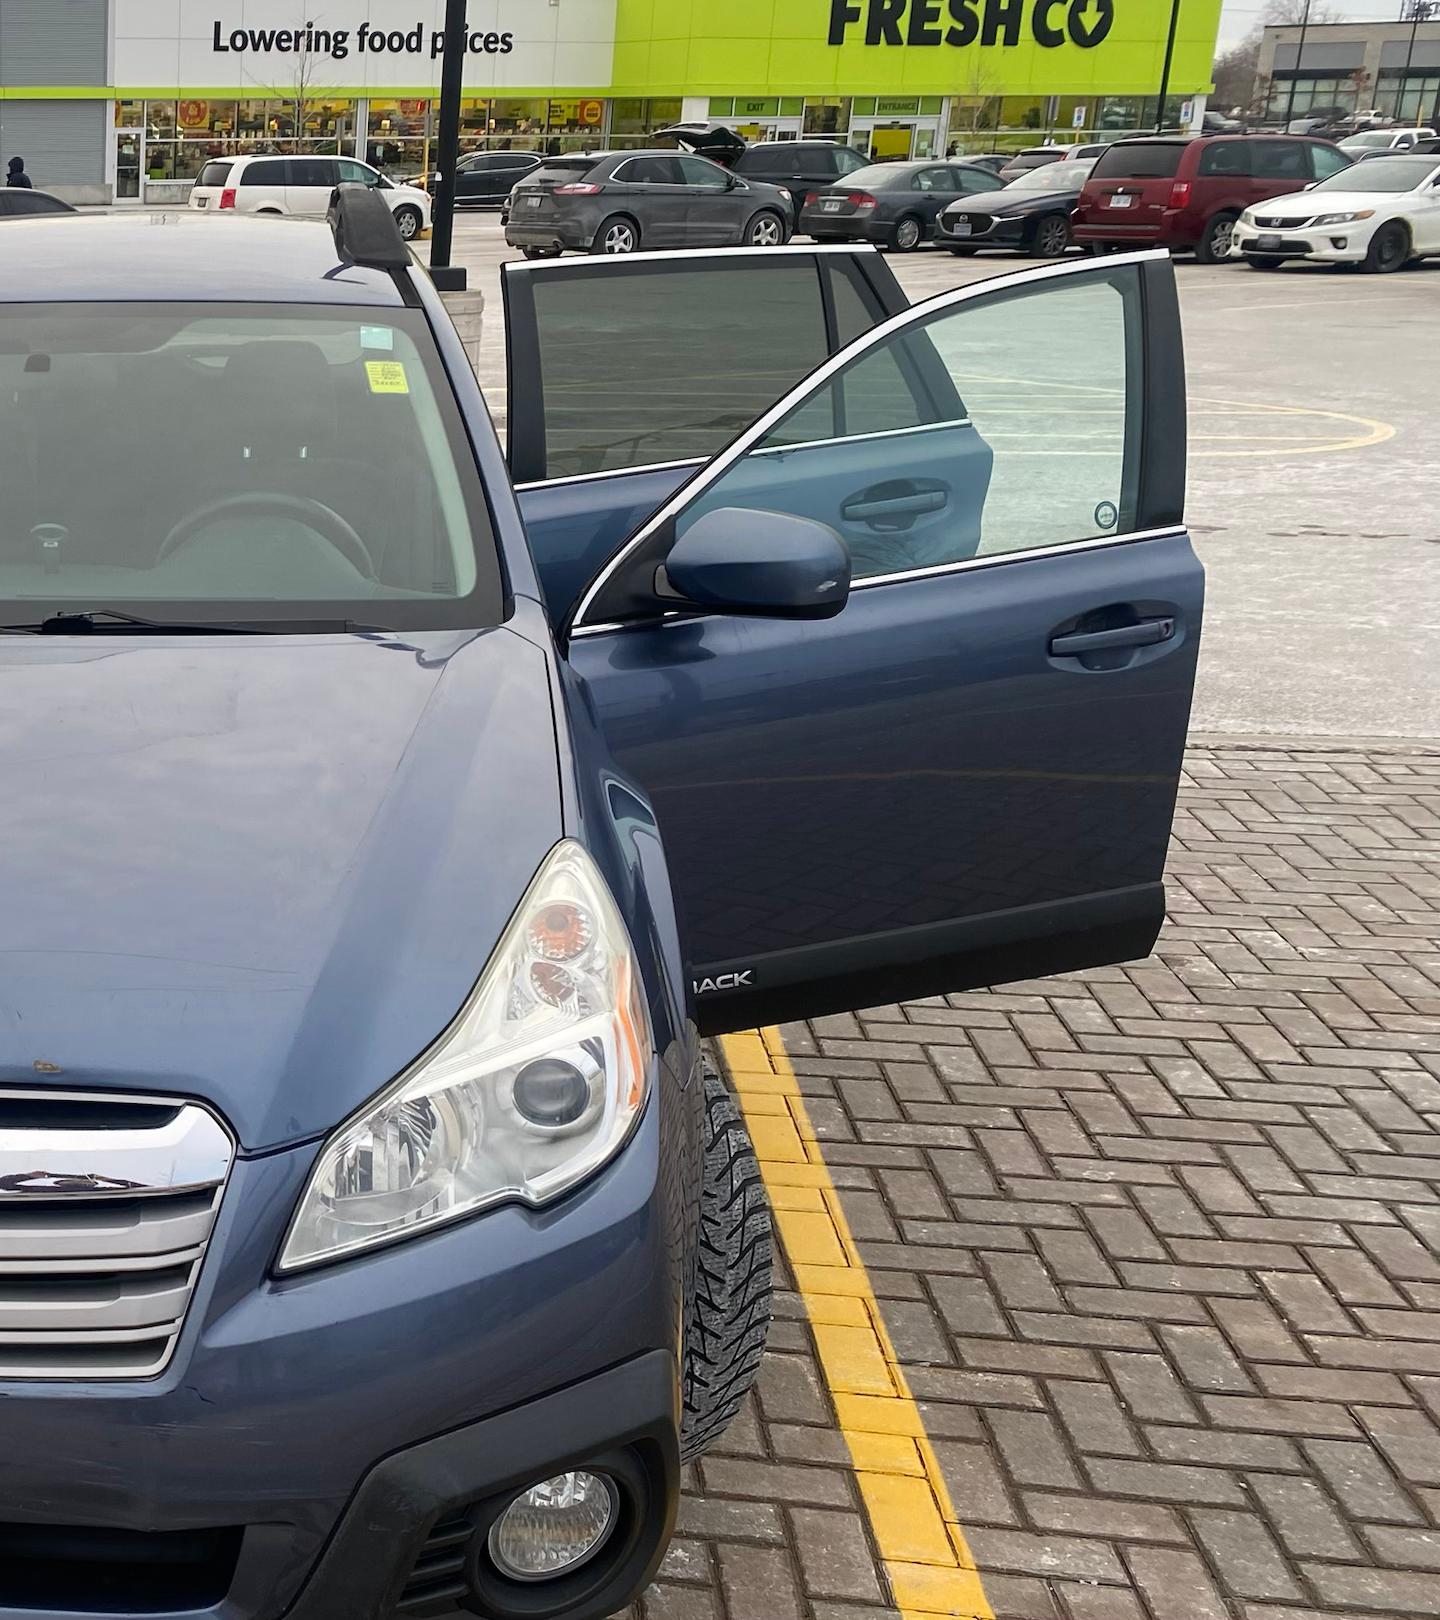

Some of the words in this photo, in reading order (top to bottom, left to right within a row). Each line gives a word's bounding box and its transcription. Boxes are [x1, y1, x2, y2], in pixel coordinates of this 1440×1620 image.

[213, 21, 349, 59] Lowering
[357, 22, 423, 53] food
[430, 23, 513, 59] pices
[746, 102, 765, 112] EXIT
[878, 102, 916, 111] ENTRANCE
